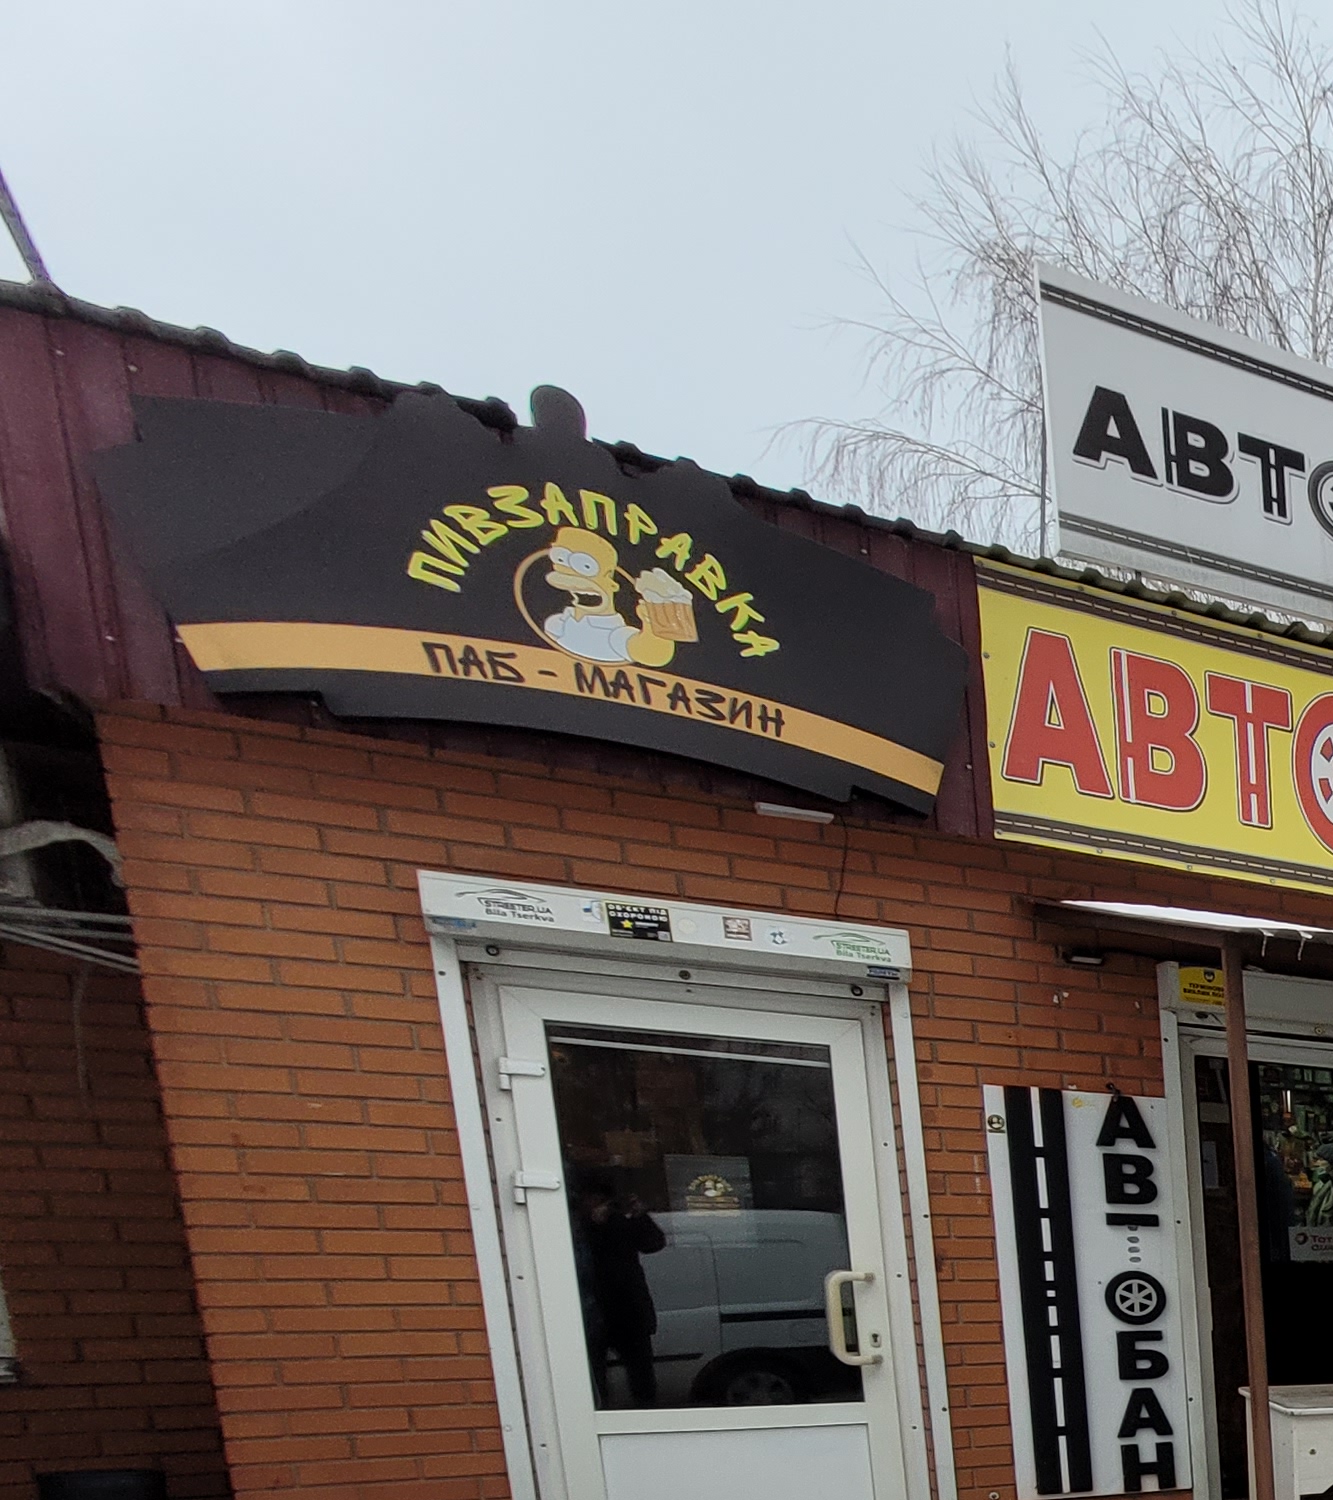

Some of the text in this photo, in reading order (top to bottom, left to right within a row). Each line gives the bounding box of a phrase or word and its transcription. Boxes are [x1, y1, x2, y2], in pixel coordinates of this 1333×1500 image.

[407, 482, 780, 657] ПИВЗАПРАВКА
[422, 641, 525, 684] ПАБ
[573, 662, 786, 738] МАГАЗИН
